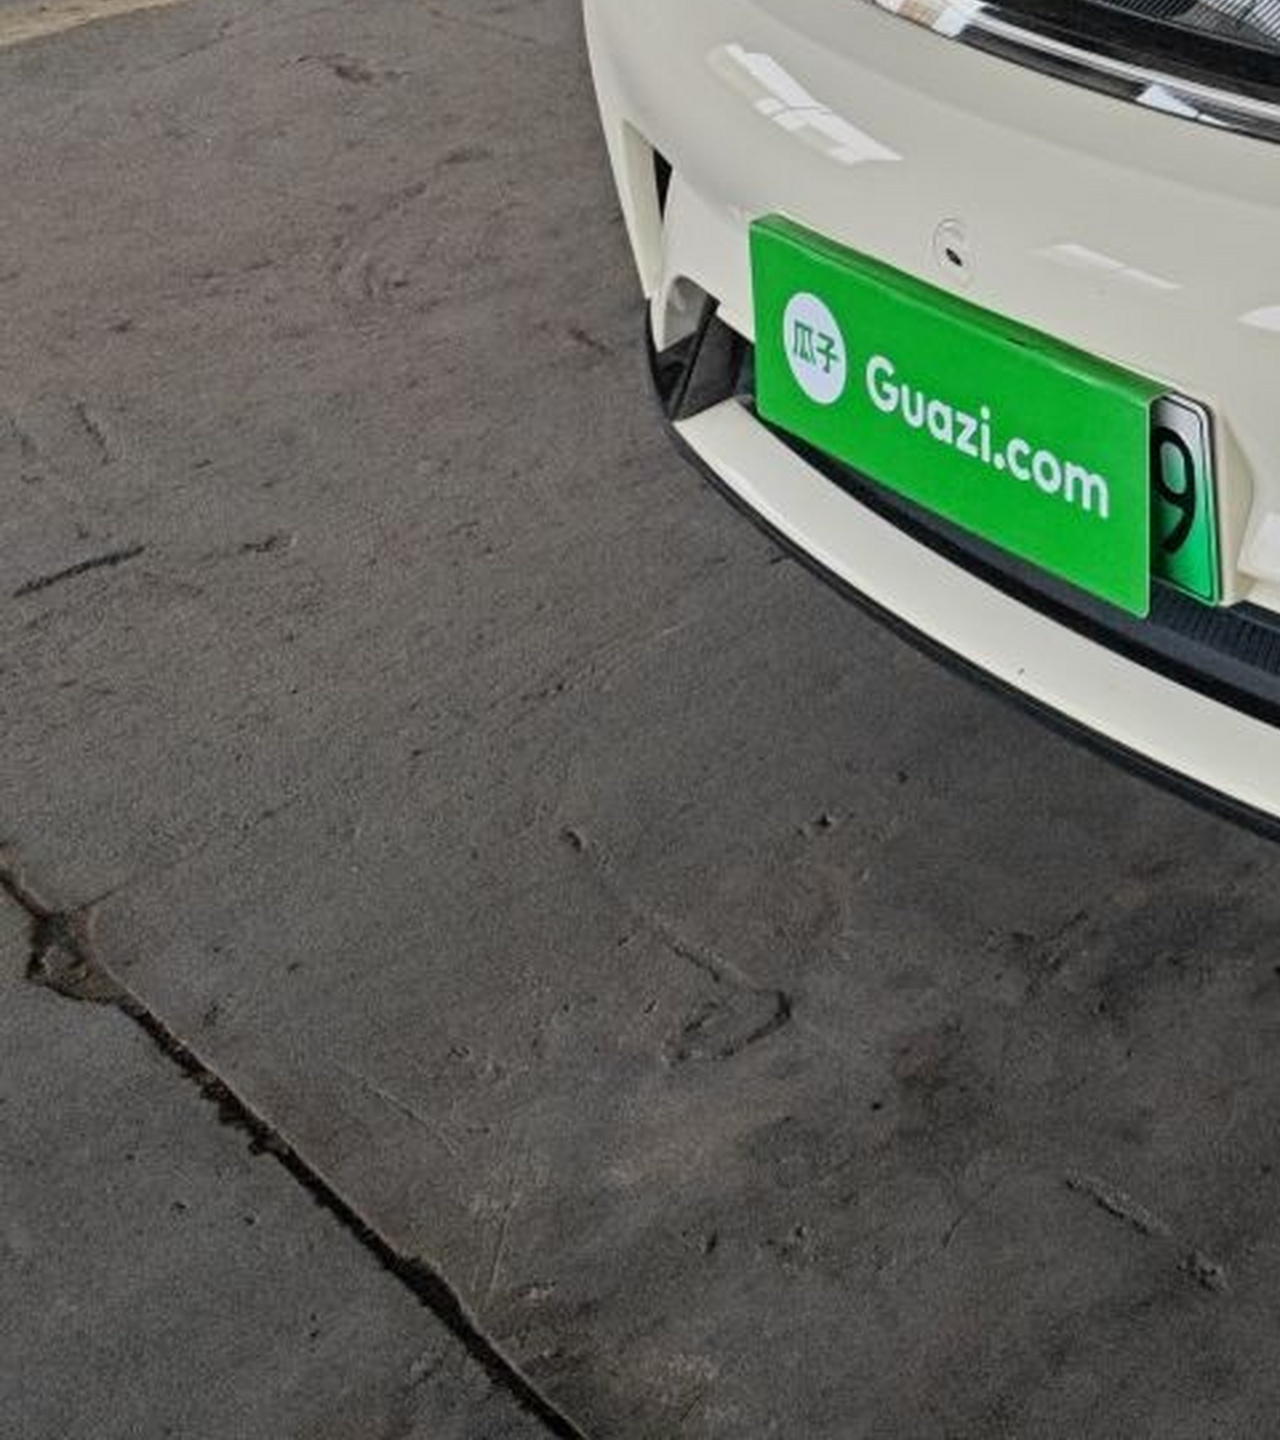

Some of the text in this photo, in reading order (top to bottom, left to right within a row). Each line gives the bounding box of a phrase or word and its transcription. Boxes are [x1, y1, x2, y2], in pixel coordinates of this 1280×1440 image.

[791, 319, 840, 374] 瓜子
[865, 356, 1110, 519] Guazi.com
[1154, 426, 1197, 553] 9
